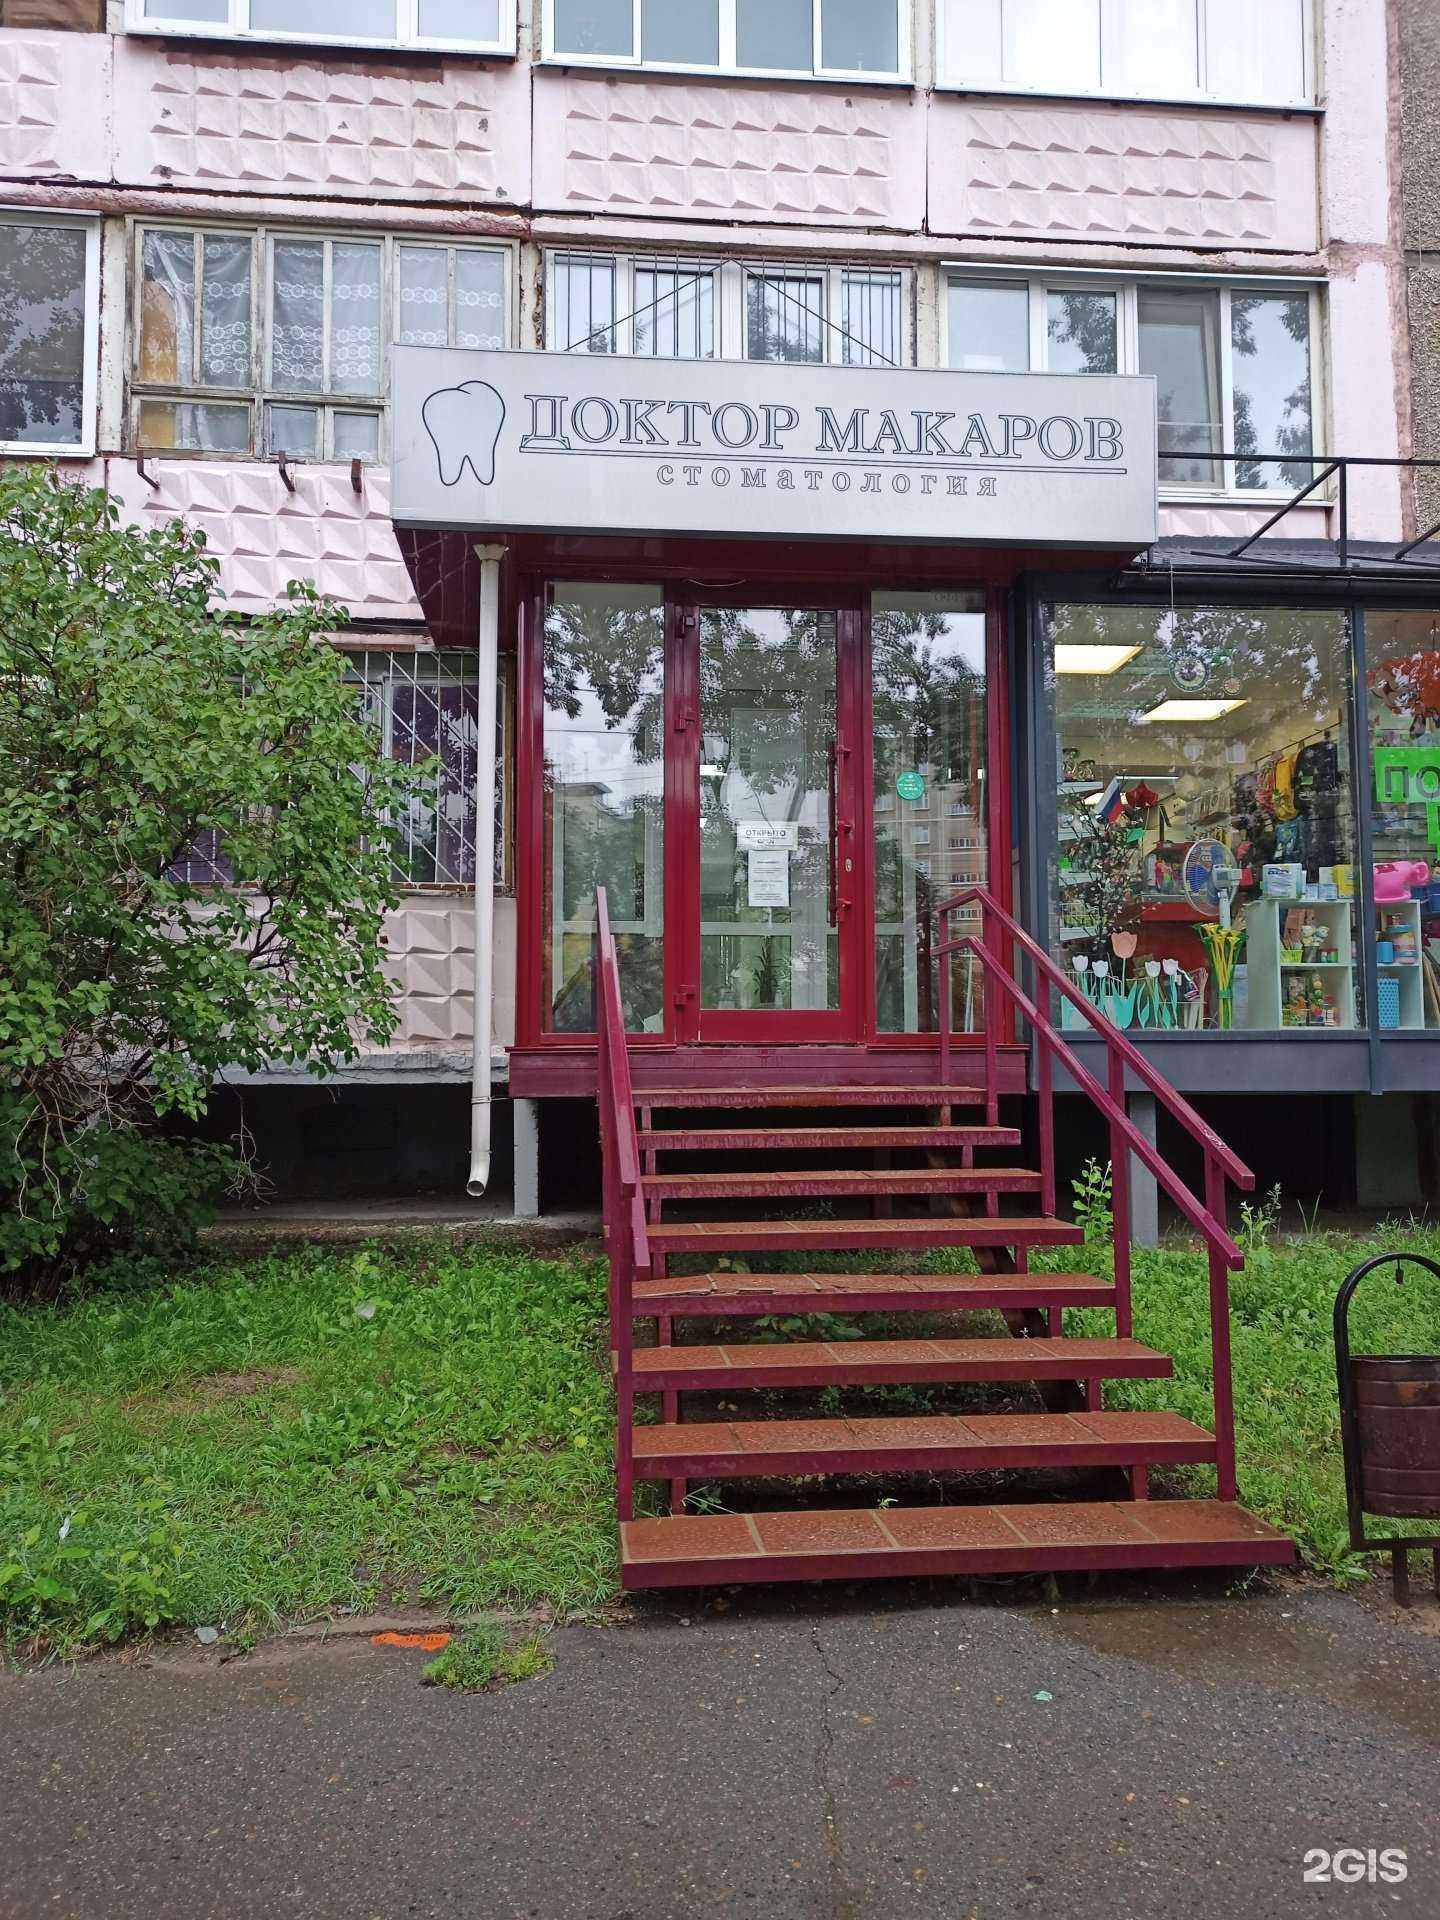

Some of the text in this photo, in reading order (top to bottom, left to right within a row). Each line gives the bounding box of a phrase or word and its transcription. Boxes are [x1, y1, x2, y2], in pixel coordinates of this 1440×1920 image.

[520, 394, 1125, 461] ДОКТОР МАКАРОВ
[656, 464, 998, 497] стоматология
